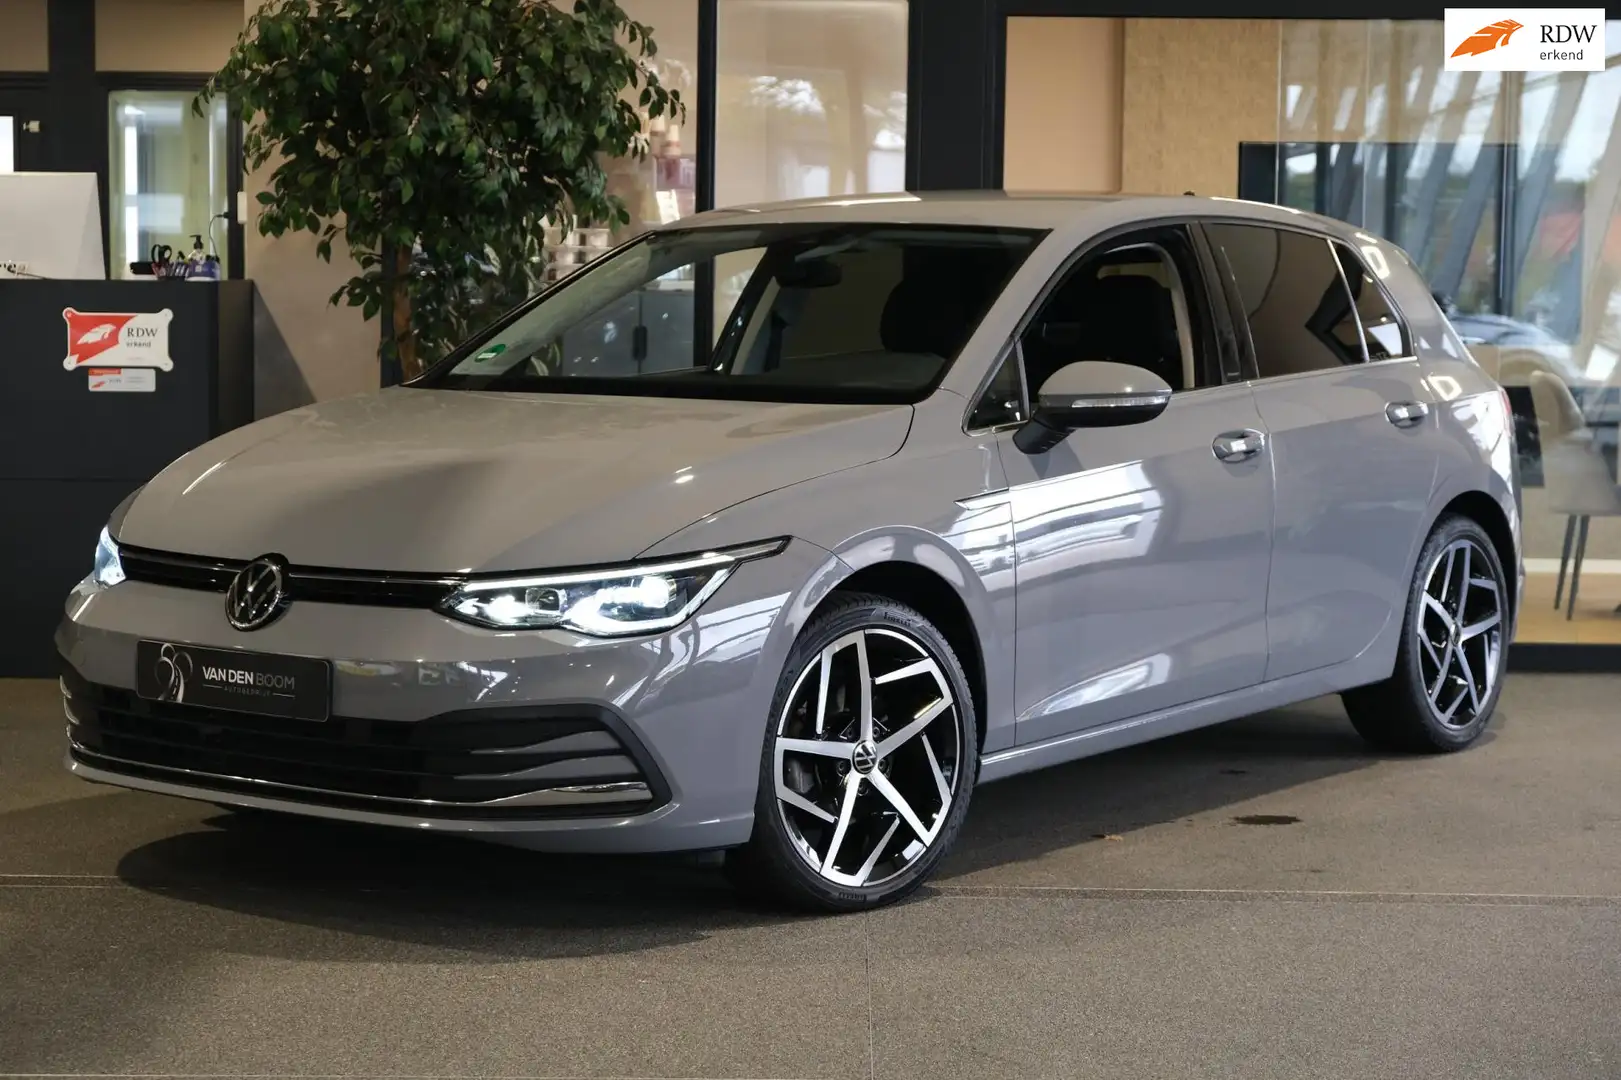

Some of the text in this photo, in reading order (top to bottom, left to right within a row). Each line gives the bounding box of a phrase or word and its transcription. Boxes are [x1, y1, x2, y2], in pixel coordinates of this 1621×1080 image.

[127, 327, 158, 338] RDW
[202, 666, 295, 690] VAN DEN BOOM
